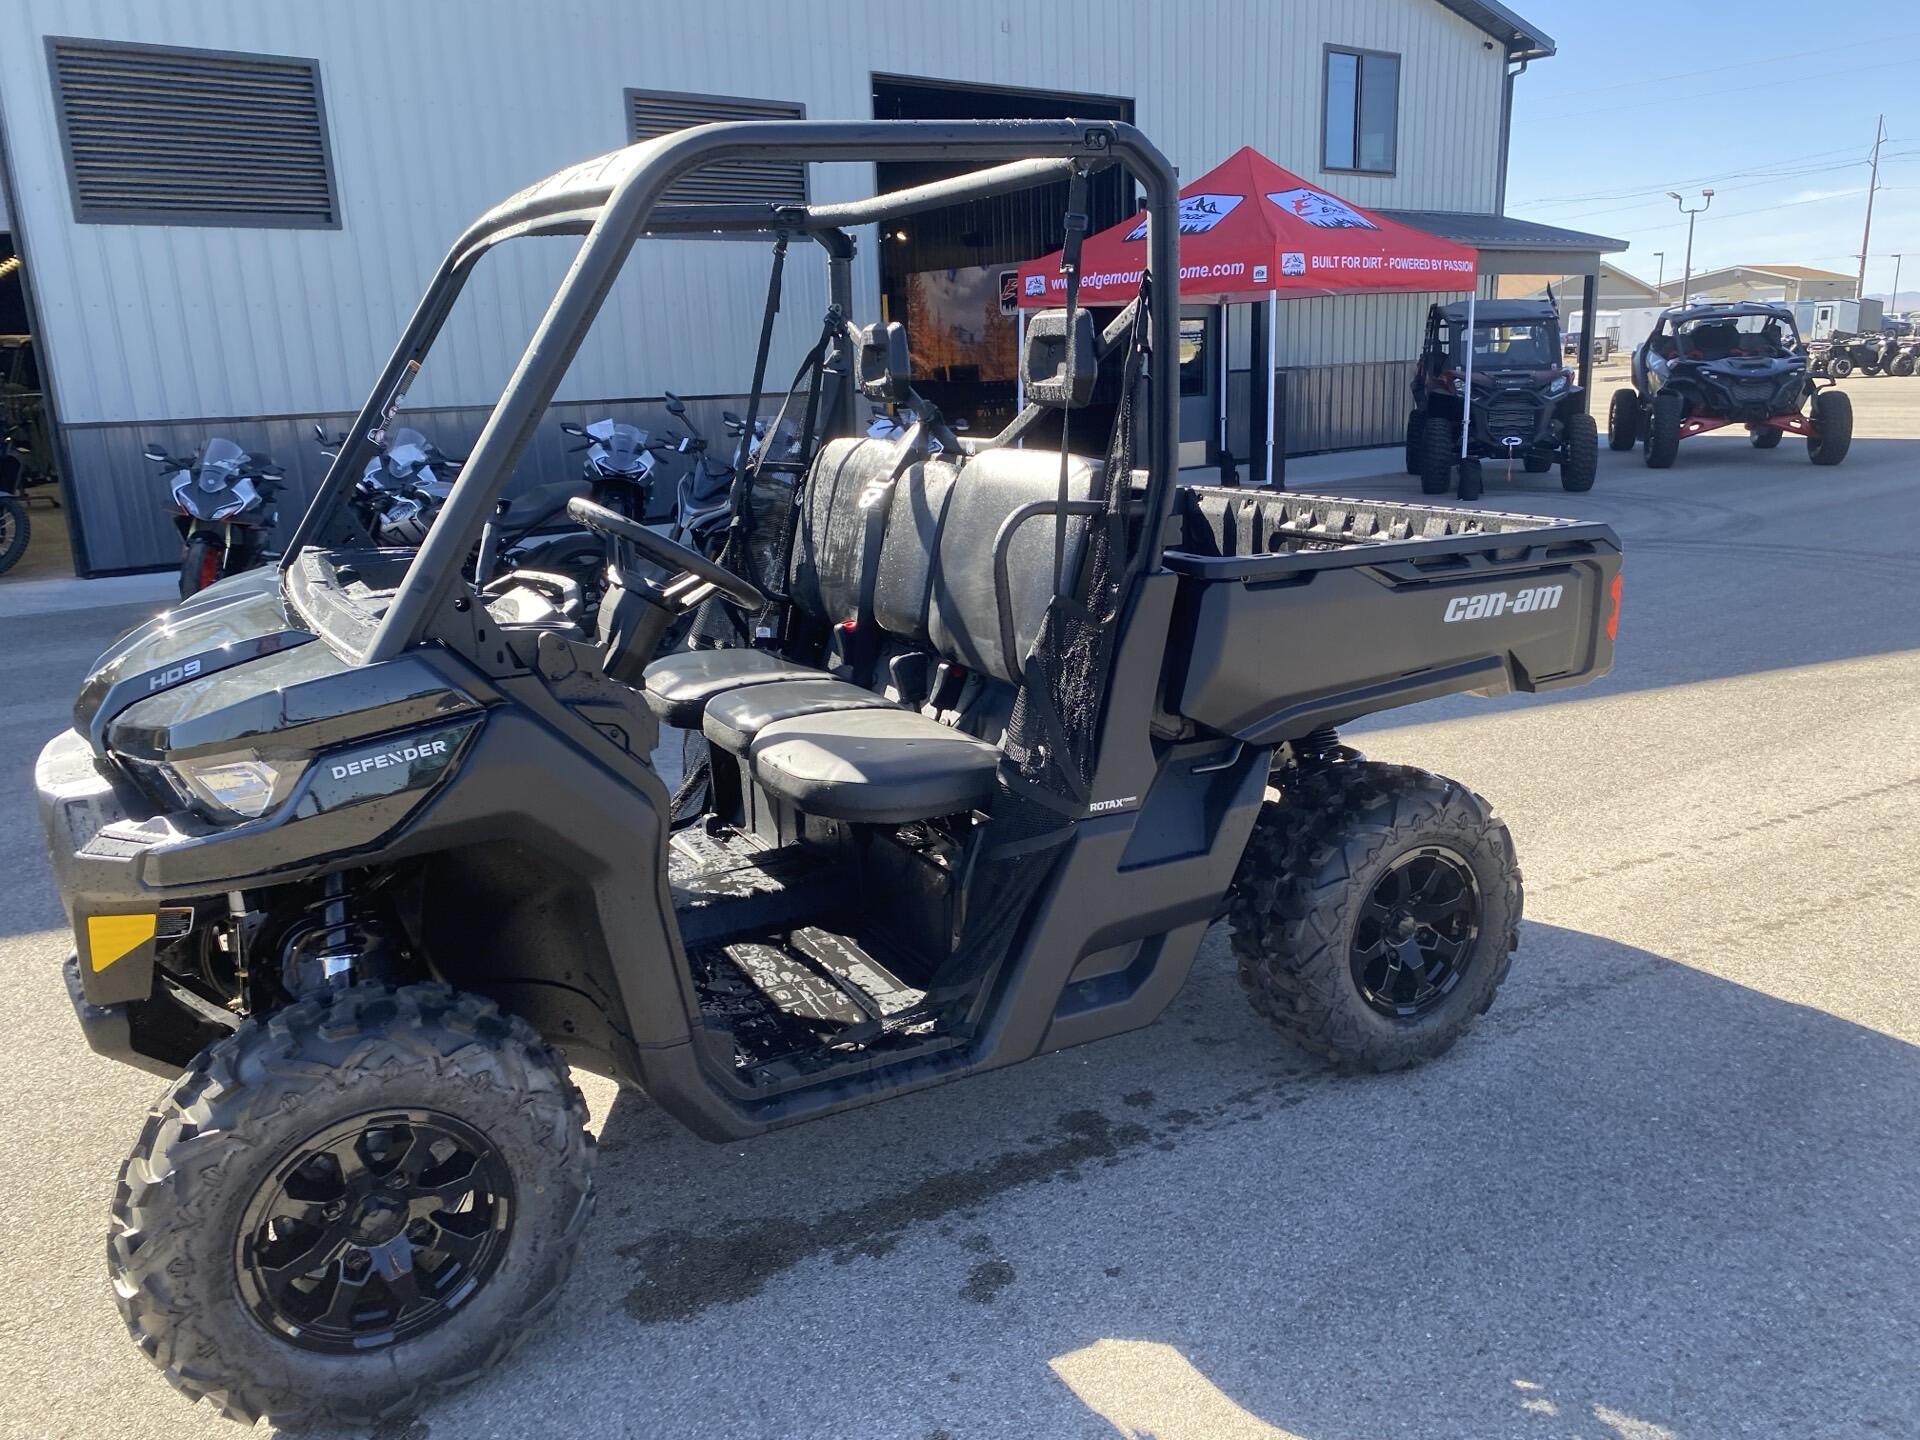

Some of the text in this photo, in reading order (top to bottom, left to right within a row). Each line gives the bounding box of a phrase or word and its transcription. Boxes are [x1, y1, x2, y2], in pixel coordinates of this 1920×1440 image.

[1051, 262, 1245, 290] ww.edgemouome.com
[1311, 255, 1340, 269] BUILT
[1341, 256, 1361, 269] FOR
[1362, 256, 1383, 269] DIRT
[1389, 257, 1431, 270] POWERED
[1431, 259, 1443, 271] BY
[1443, 259, 1474, 272] PASSION
[1443, 584, 1563, 623] can-am
[149, 659, 201, 690] HD9
[331, 740, 447, 780] DEFENDER
[1089, 798, 1124, 812] ROTAX
